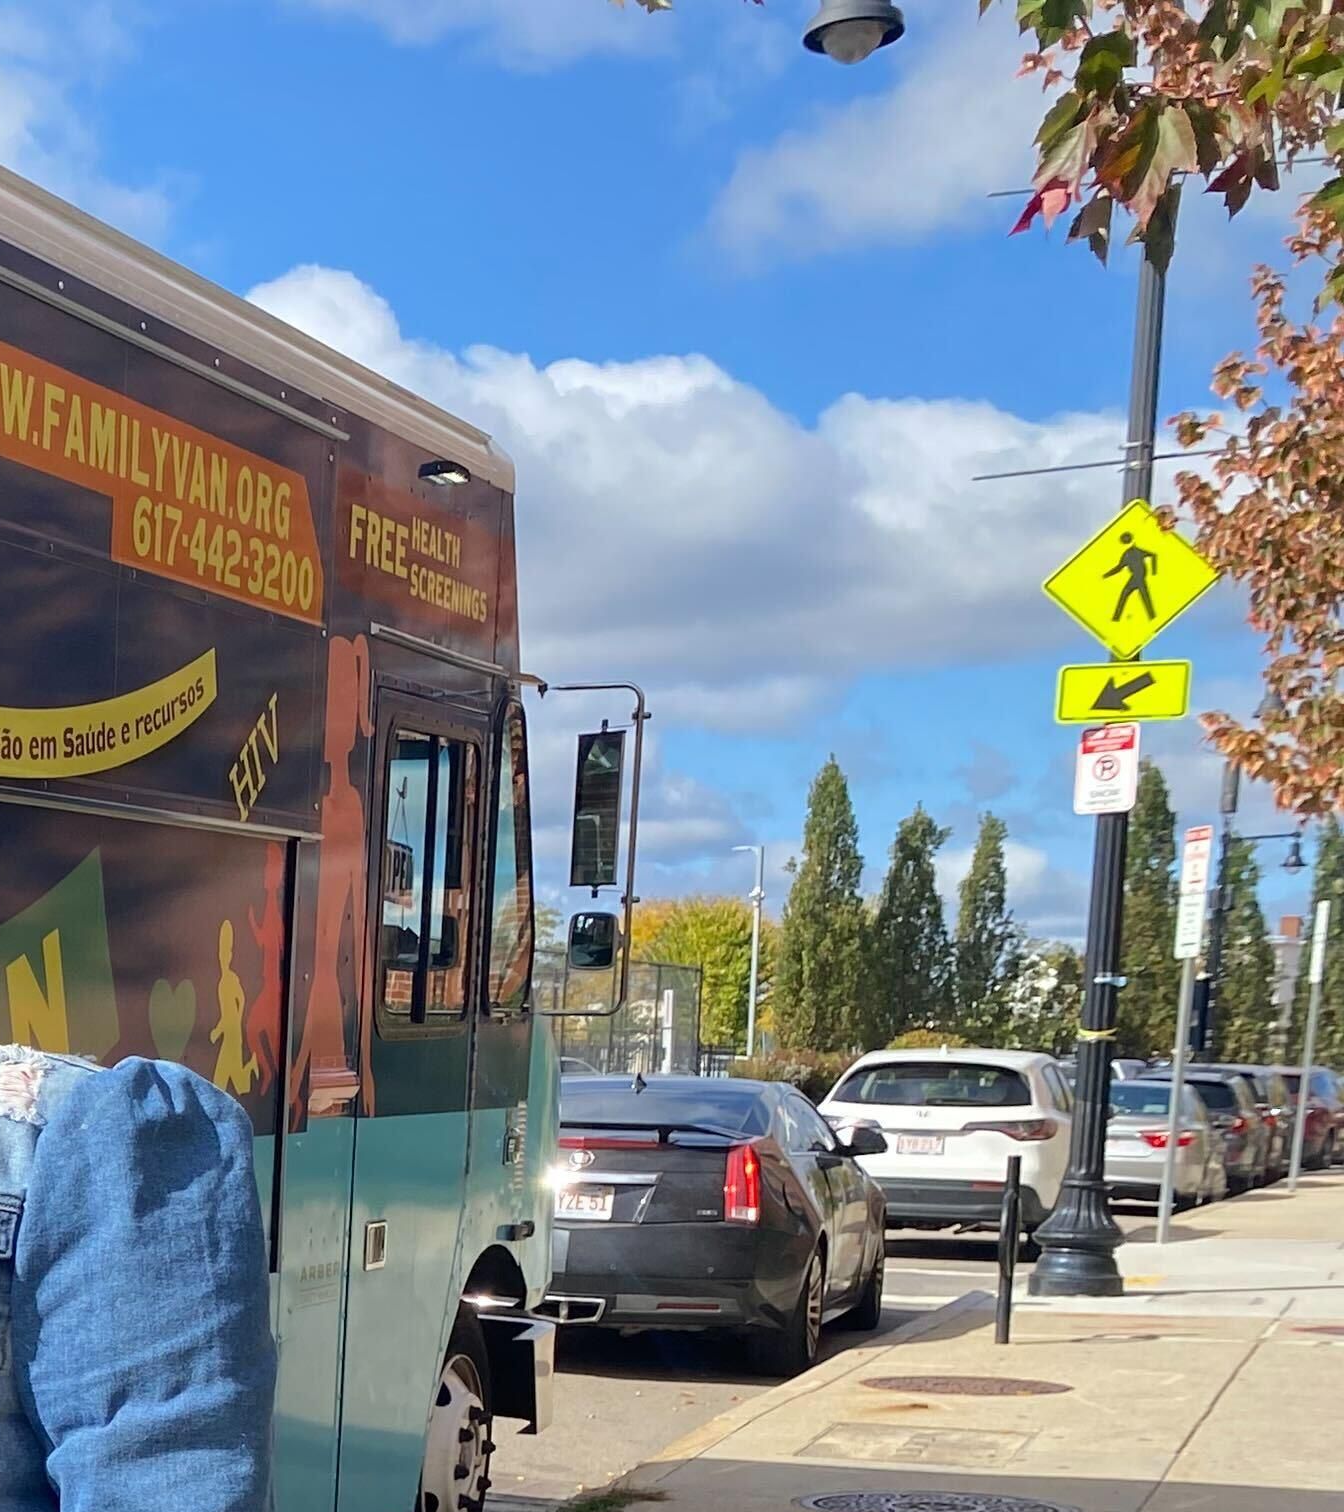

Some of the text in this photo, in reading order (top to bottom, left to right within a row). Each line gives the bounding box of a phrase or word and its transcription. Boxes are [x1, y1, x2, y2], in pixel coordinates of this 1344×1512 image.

[132, 496, 314, 610] 617-442-3200
[349, 504, 409, 579] FREE
[411, 516, 461, 569] HEALTH
[409, 562, 488, 622] SCREENINGS
[29, 736, 57, 758] em
[63, 722, 116, 757] Saúde
[120, 724, 131, 742] e
[135, 676, 205, 739] recursos
[229, 693, 280, 822] HIV
